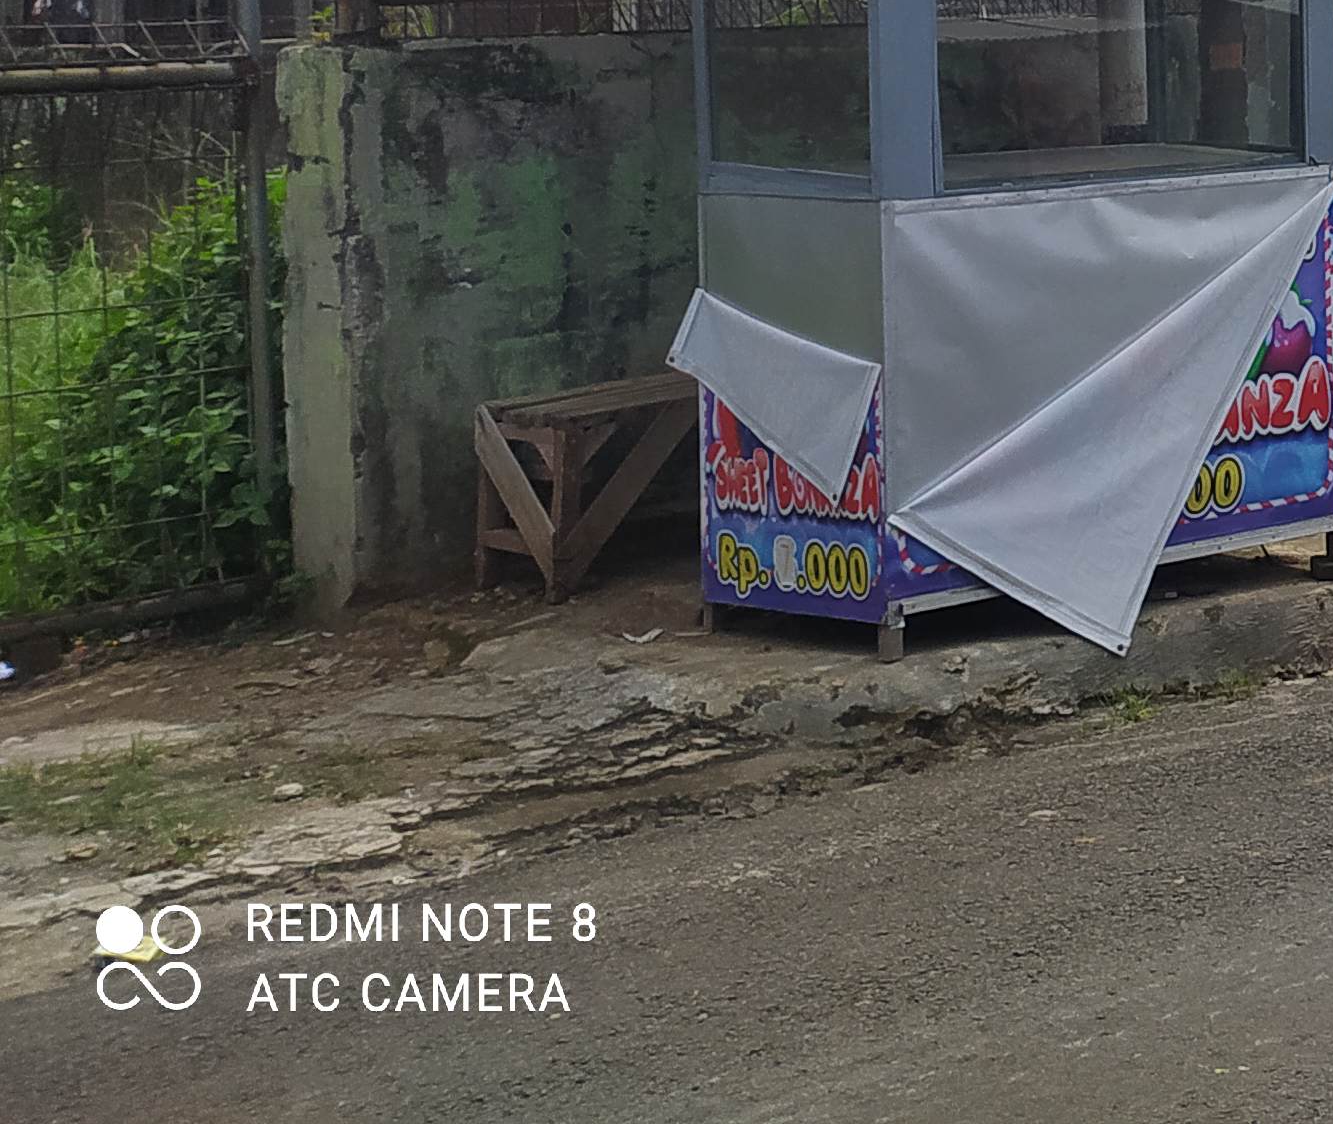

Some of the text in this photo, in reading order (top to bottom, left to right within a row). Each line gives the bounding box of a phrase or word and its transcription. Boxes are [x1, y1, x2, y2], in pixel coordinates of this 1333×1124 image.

[711, 444, 881, 524] SWEET BOZA
[716, 529, 871, 601] Rp. .000
